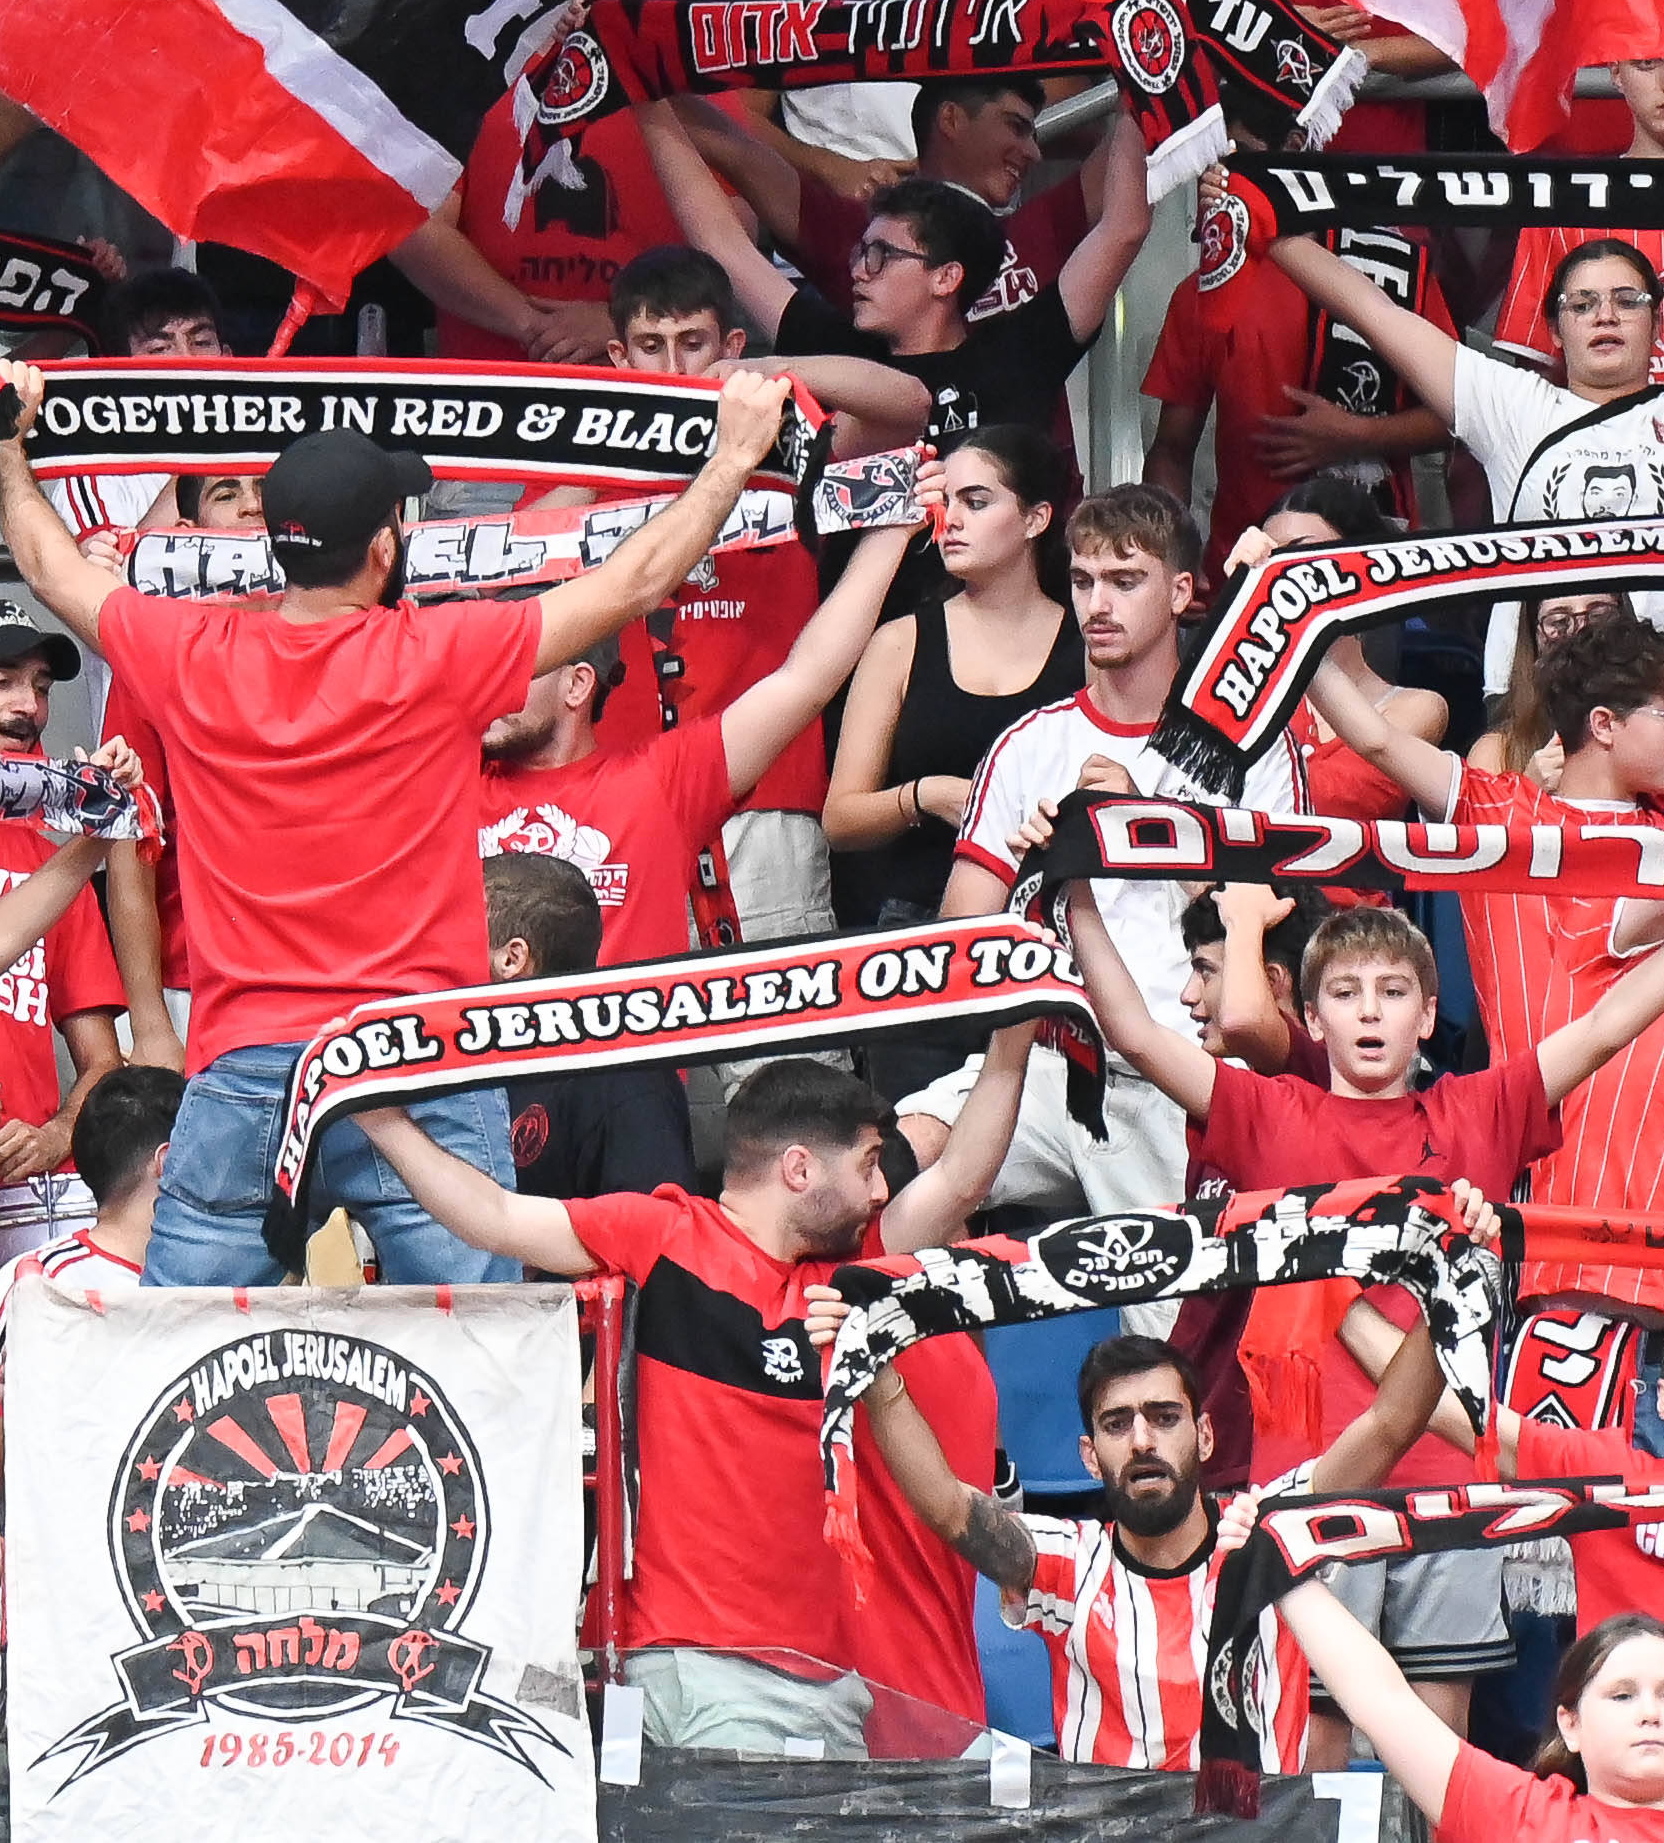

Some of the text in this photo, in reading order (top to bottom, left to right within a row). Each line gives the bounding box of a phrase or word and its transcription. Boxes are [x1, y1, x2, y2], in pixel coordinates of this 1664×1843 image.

[1266, 164, 1655, 214] ירושלים
[321, 393, 375, 434] IN
[390, 396, 503, 439] RED
[518, 402, 565, 442] &
[1214, 557, 1359, 720] HAPOEL
[280, 1017, 441, 1181] HAPOEL
[458, 963, 837, 1052] JERUSALEM
[858, 943, 944, 999] ON
[1064, 1255, 1179, 1291] ירושלים
[189, 1331, 409, 1417] HAPOEL JERUSALEM
[230, 1615, 362, 1675] מלחה
[197, 1731, 403, 1769] 1985-2014
